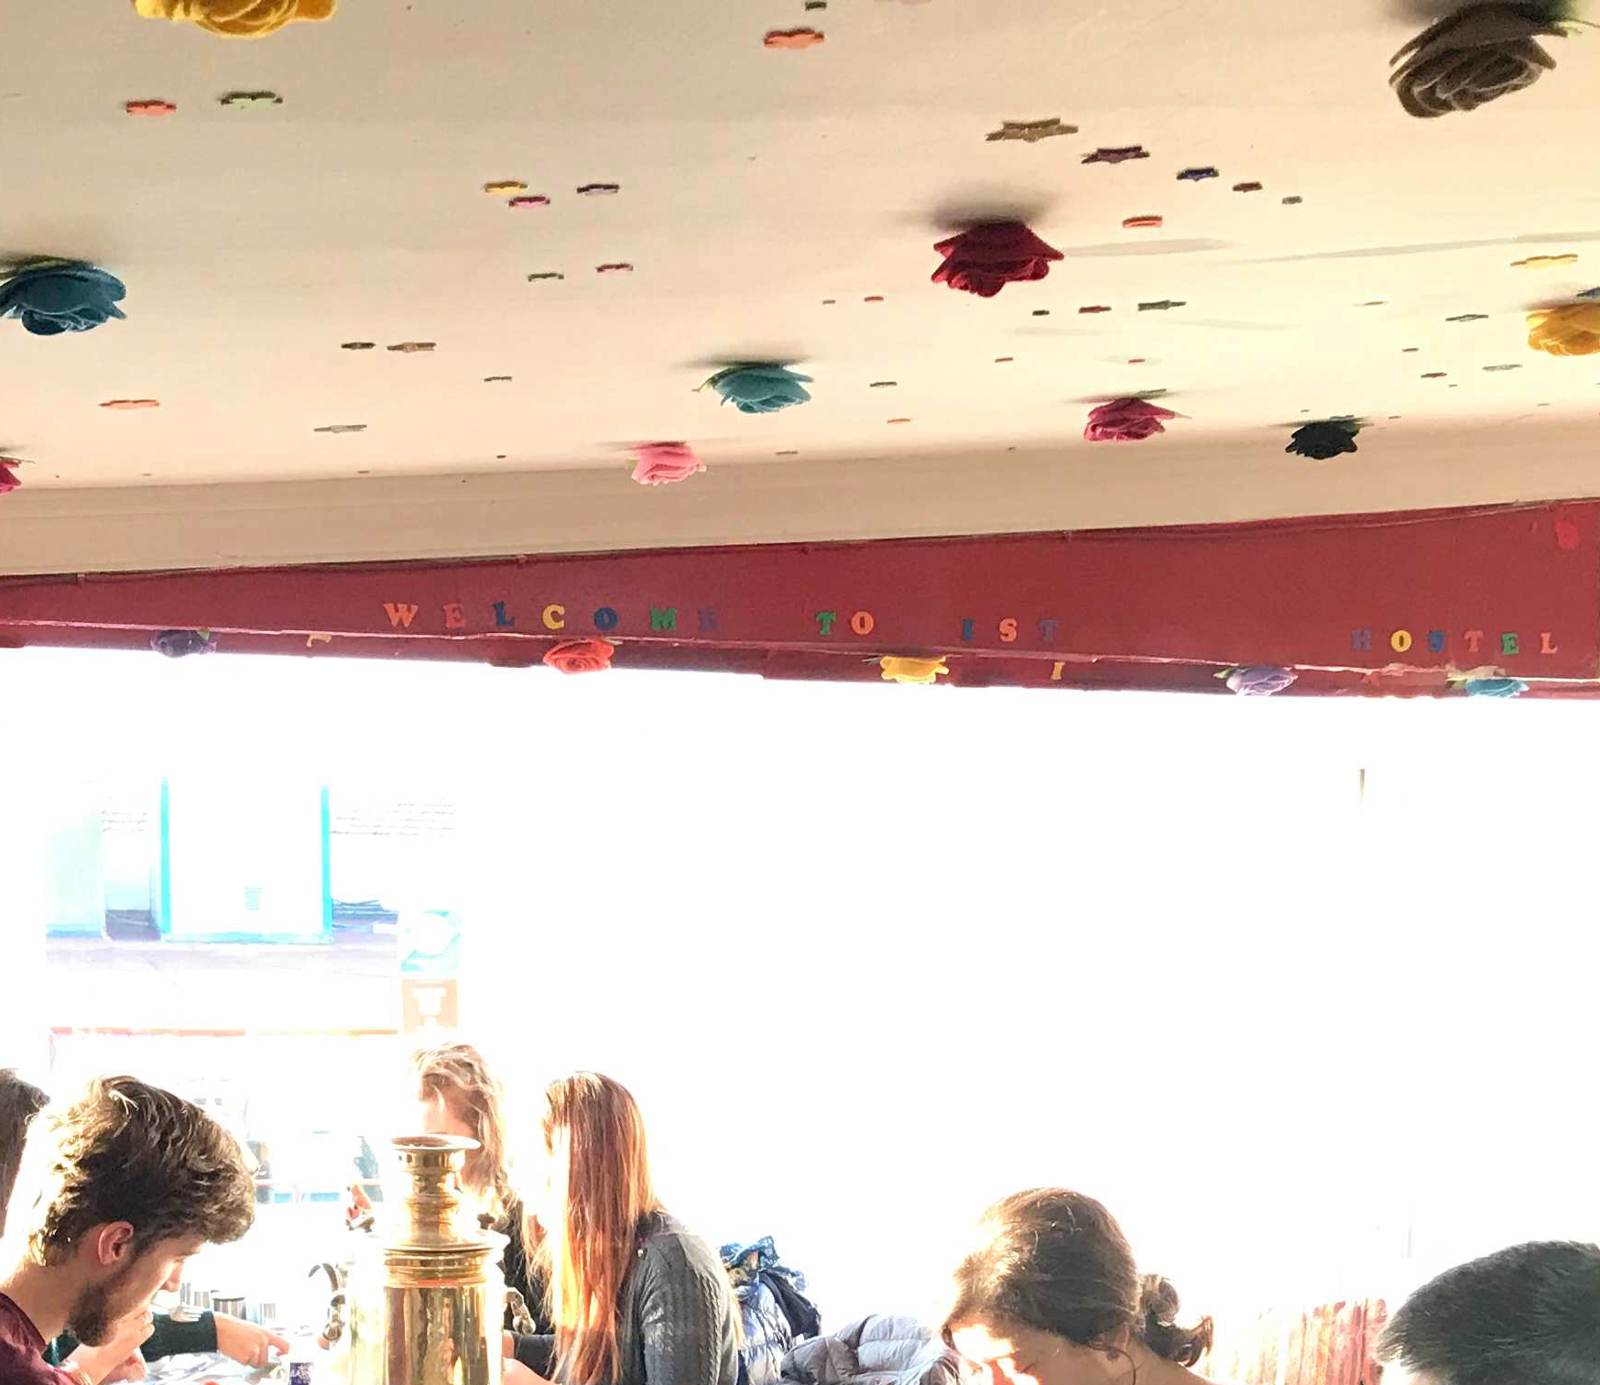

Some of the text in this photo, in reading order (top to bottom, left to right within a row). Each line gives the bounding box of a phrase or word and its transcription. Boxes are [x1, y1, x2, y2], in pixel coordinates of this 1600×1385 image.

[383, 601, 718, 630] WELCOME
[815, 611, 874, 636] TO
[1352, 629, 1557, 655] HOSTEL
